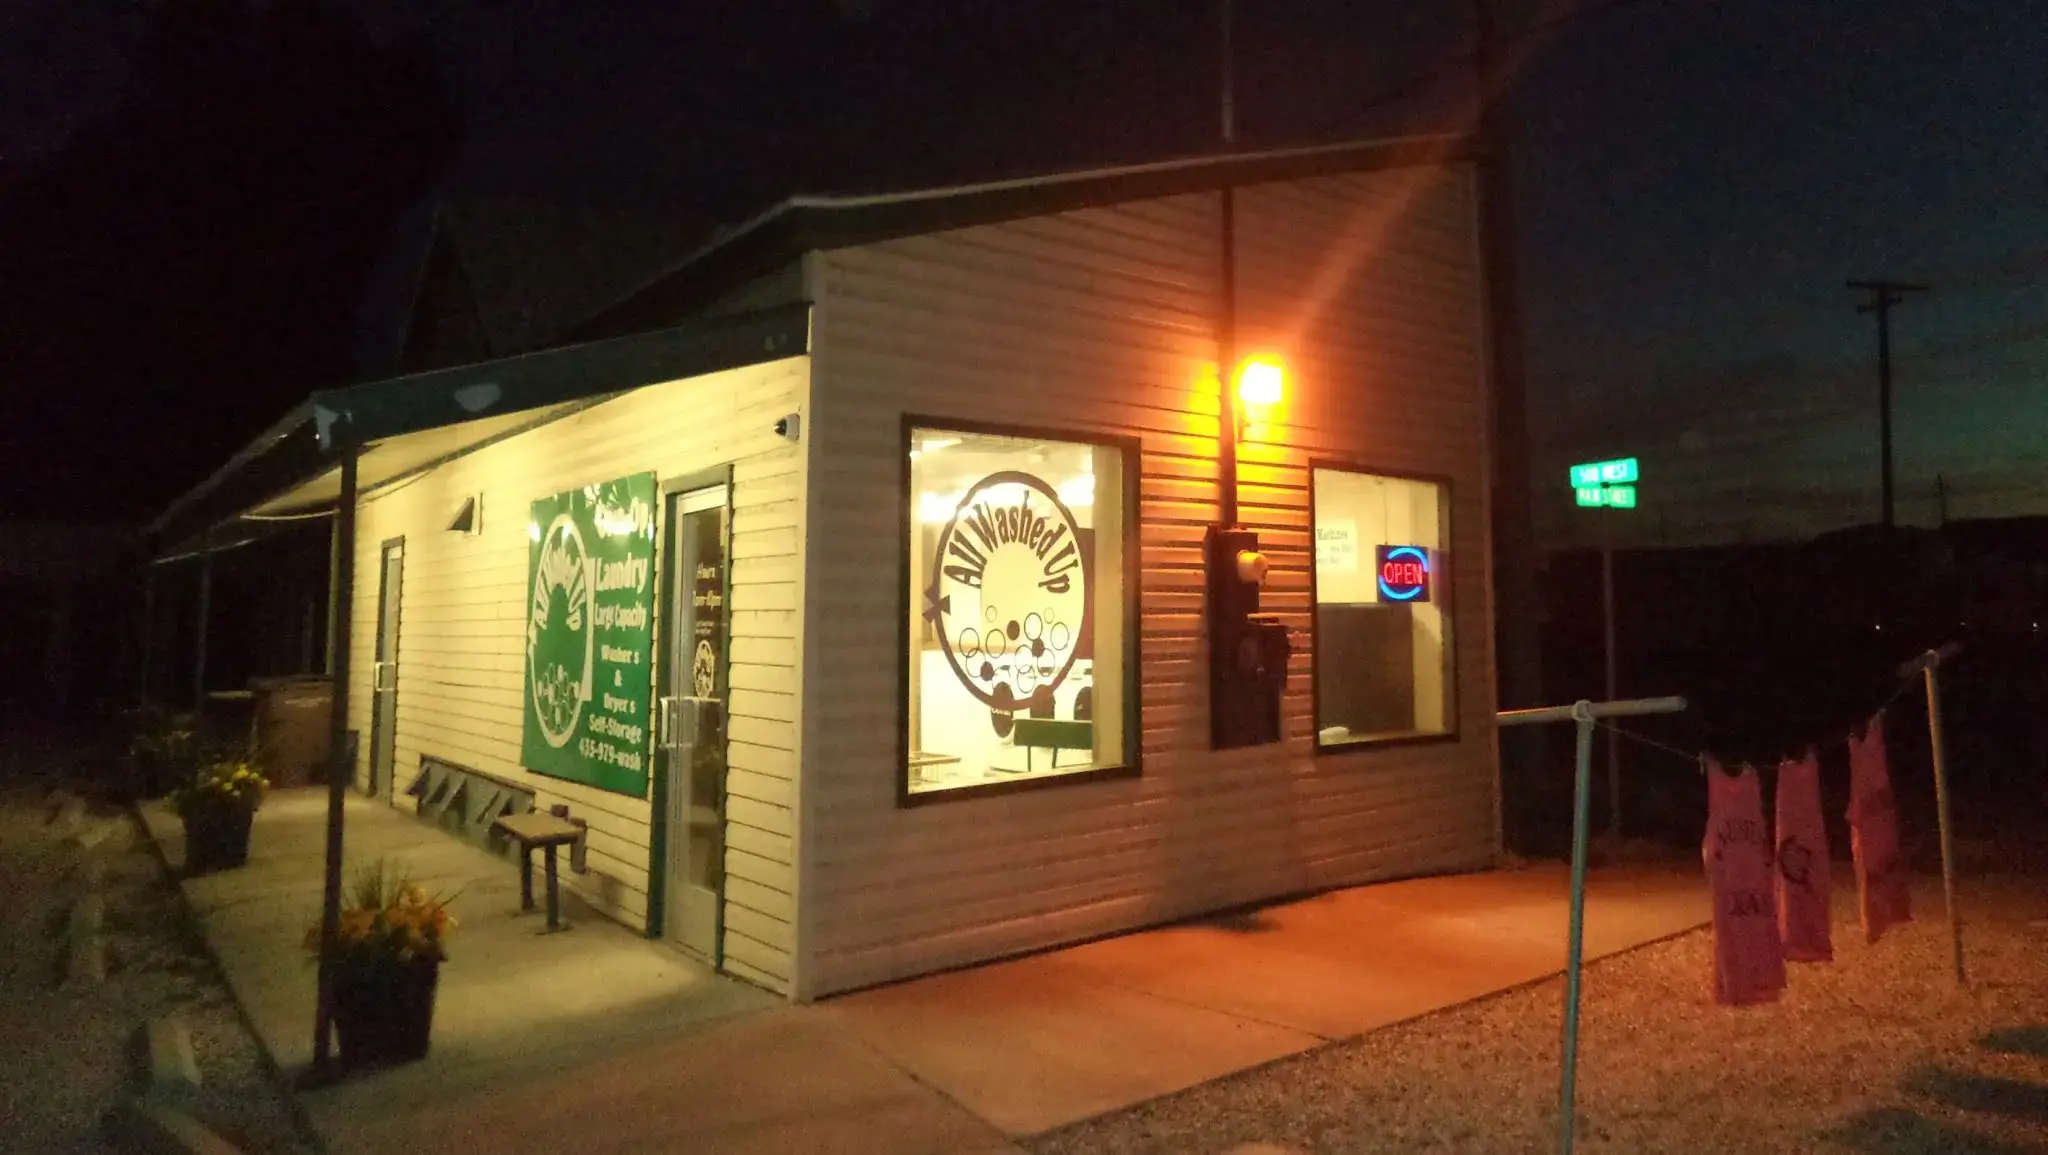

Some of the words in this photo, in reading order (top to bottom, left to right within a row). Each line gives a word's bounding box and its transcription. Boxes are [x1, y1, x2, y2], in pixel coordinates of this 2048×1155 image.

[964, 490, 1067, 561] Washed
[944, 528, 987, 589] All
[1038, 540, 1078, 593] Up
[1383, 562, 1423, 585] OPEN
[615, 600, 647, 631] Capacity
[613, 669, 623, 687] &
